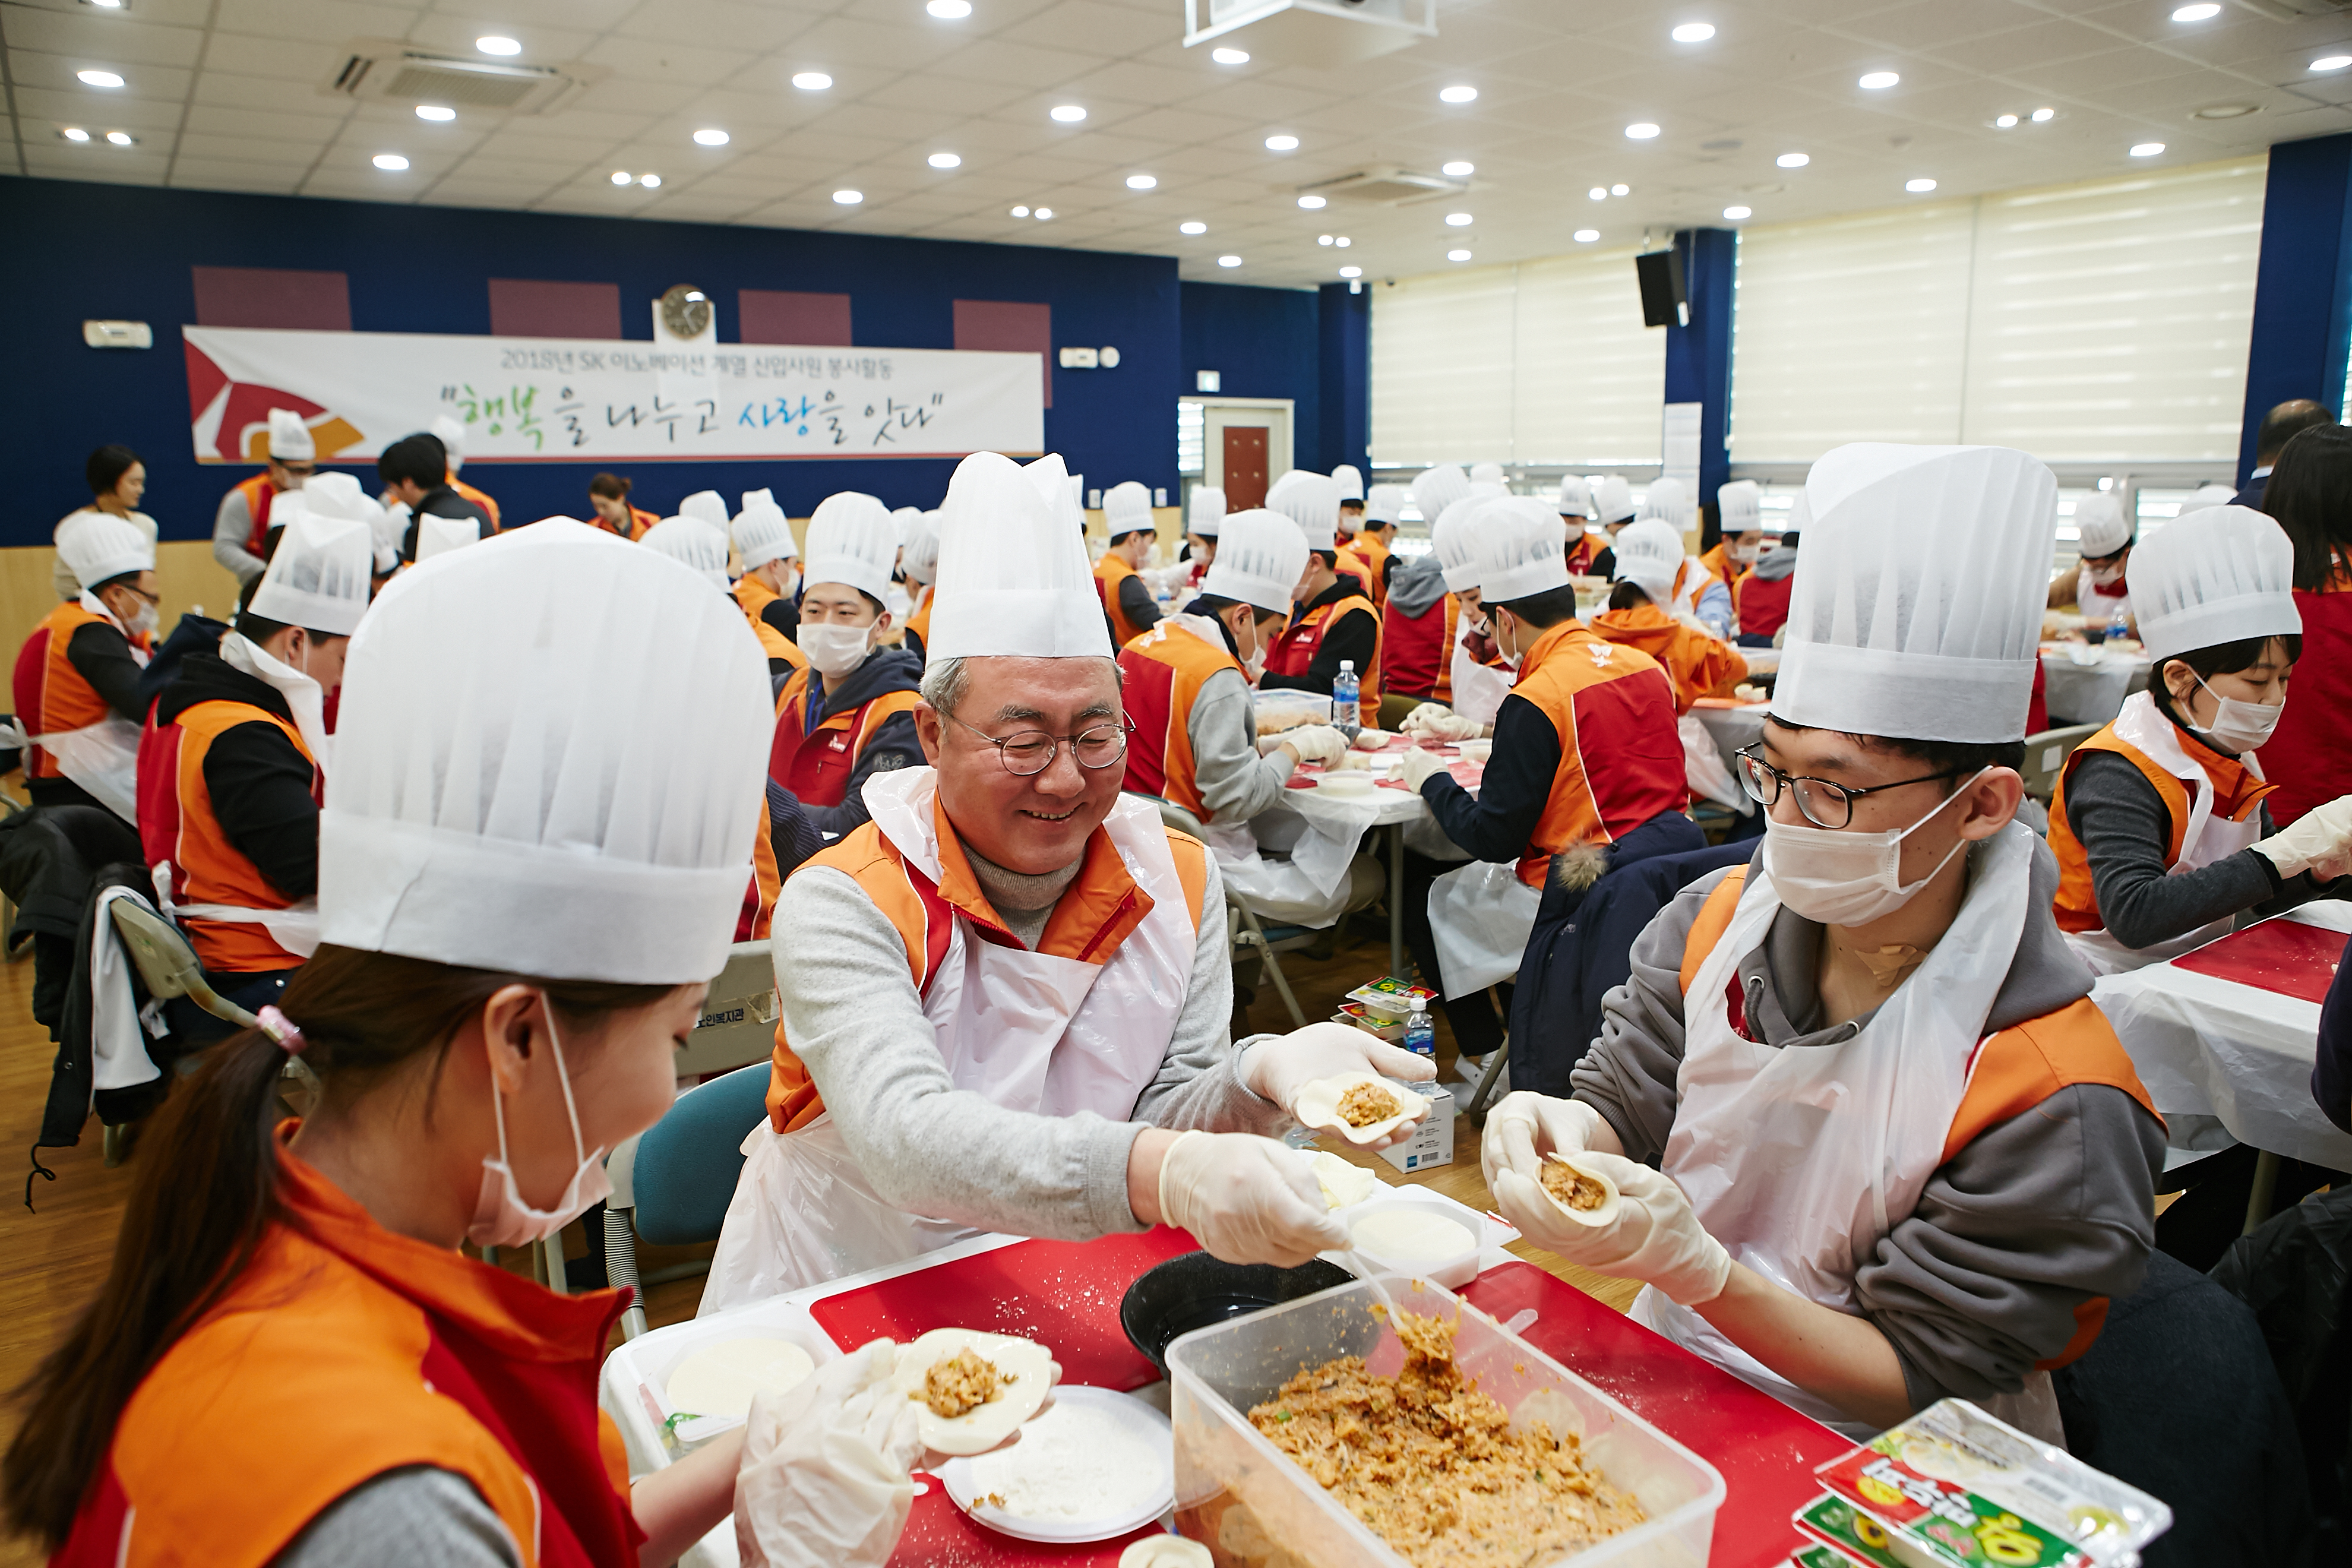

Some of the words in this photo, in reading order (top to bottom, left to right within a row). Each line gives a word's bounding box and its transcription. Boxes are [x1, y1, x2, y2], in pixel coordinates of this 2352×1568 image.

[500, 348, 573, 374] 2018년
[579, 350, 605, 371] SK
[610, 352, 705, 376] 이노베이션
[713, 355, 746, 378] 계열
[755, 355, 821, 378] 신입사원
[828, 358, 893, 380] 봉사활동
[607, 396, 719, 442] 나누고
[738, 389, 848, 445] 사랑을
[1860, 1457, 1978, 1529] 만두피
